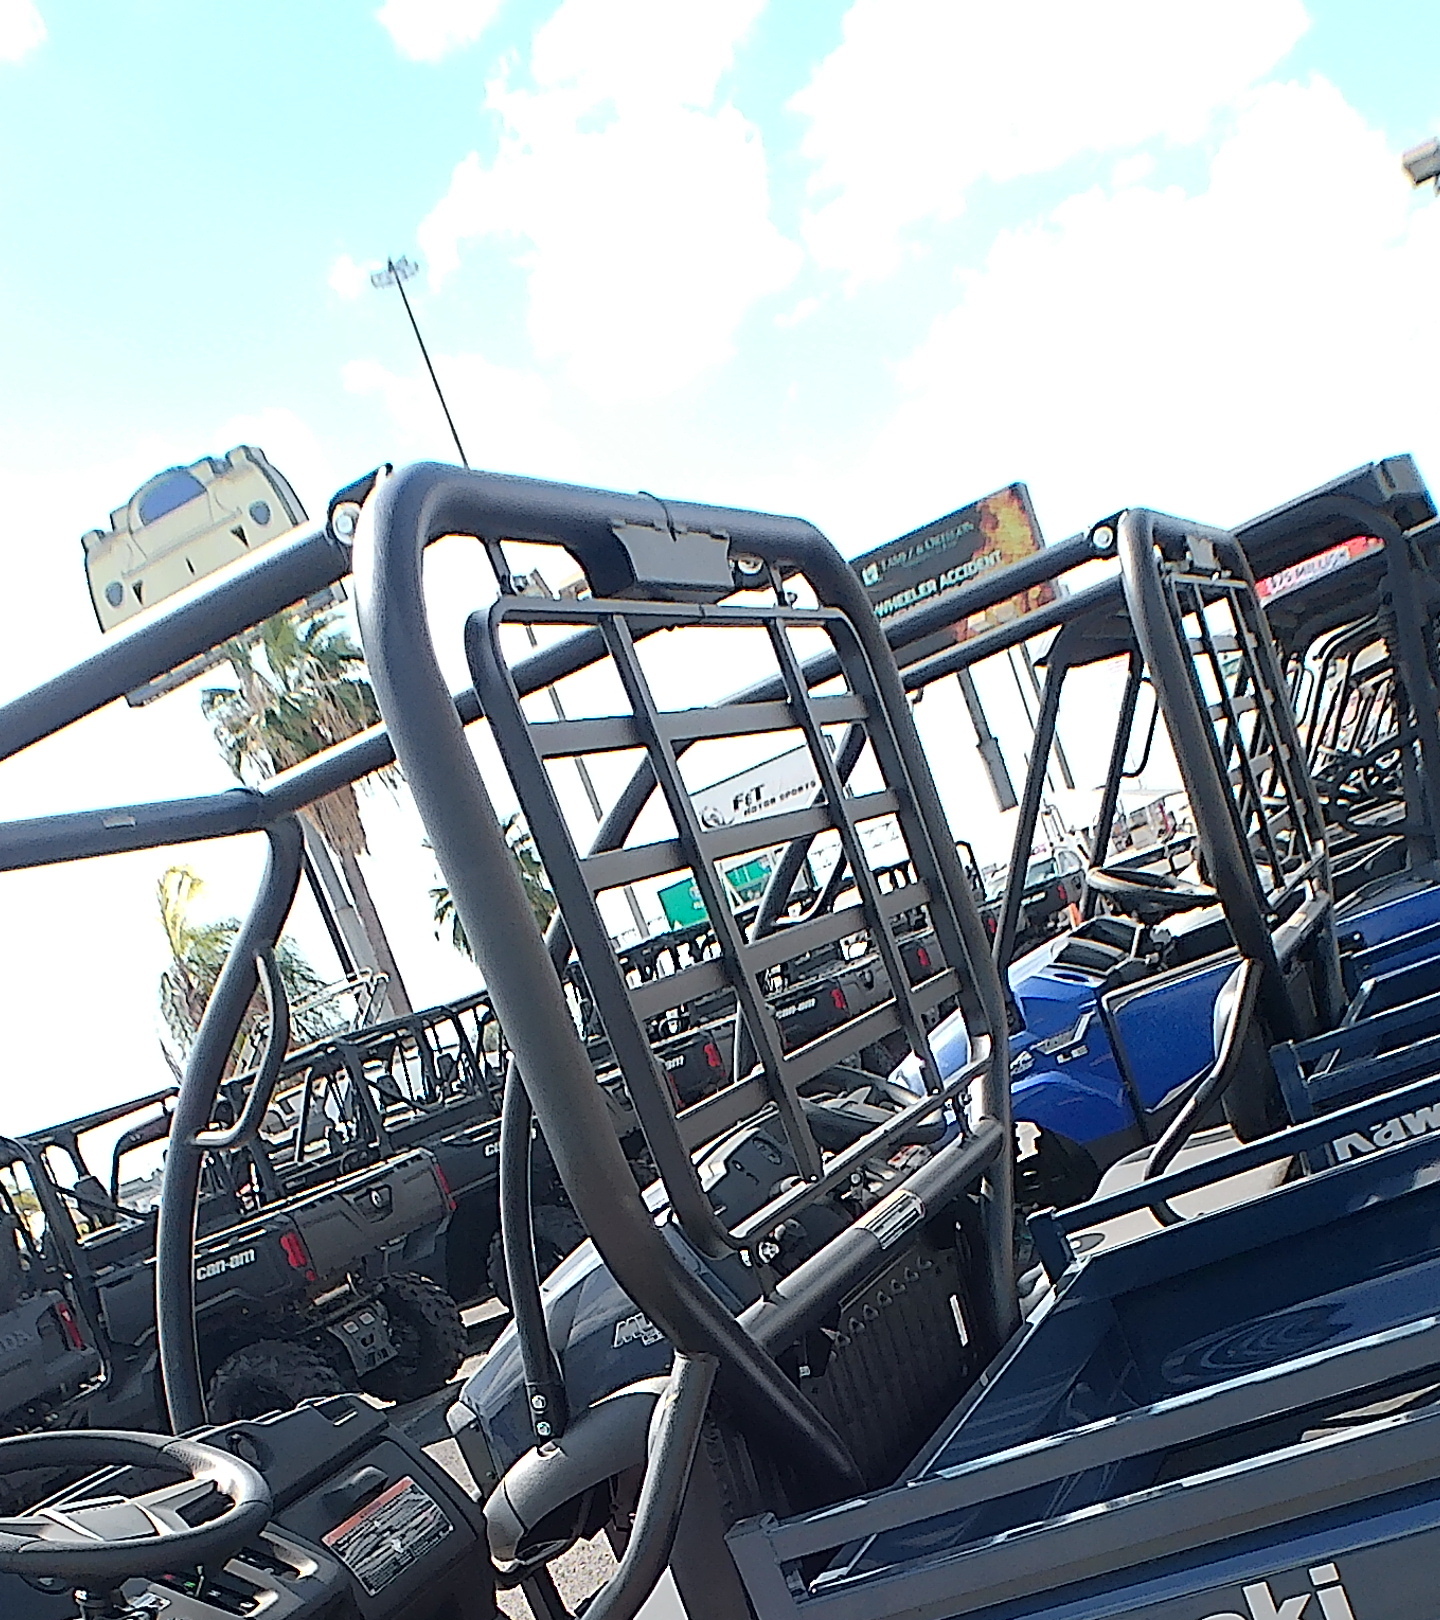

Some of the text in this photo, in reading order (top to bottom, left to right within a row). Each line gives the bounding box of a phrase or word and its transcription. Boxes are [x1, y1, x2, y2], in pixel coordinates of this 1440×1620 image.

[940, 549, 1002, 590] ACCIDENT
[743, 780, 817, 817] MOTOR SPORTS
[195, 1248, 256, 1281] can-am
